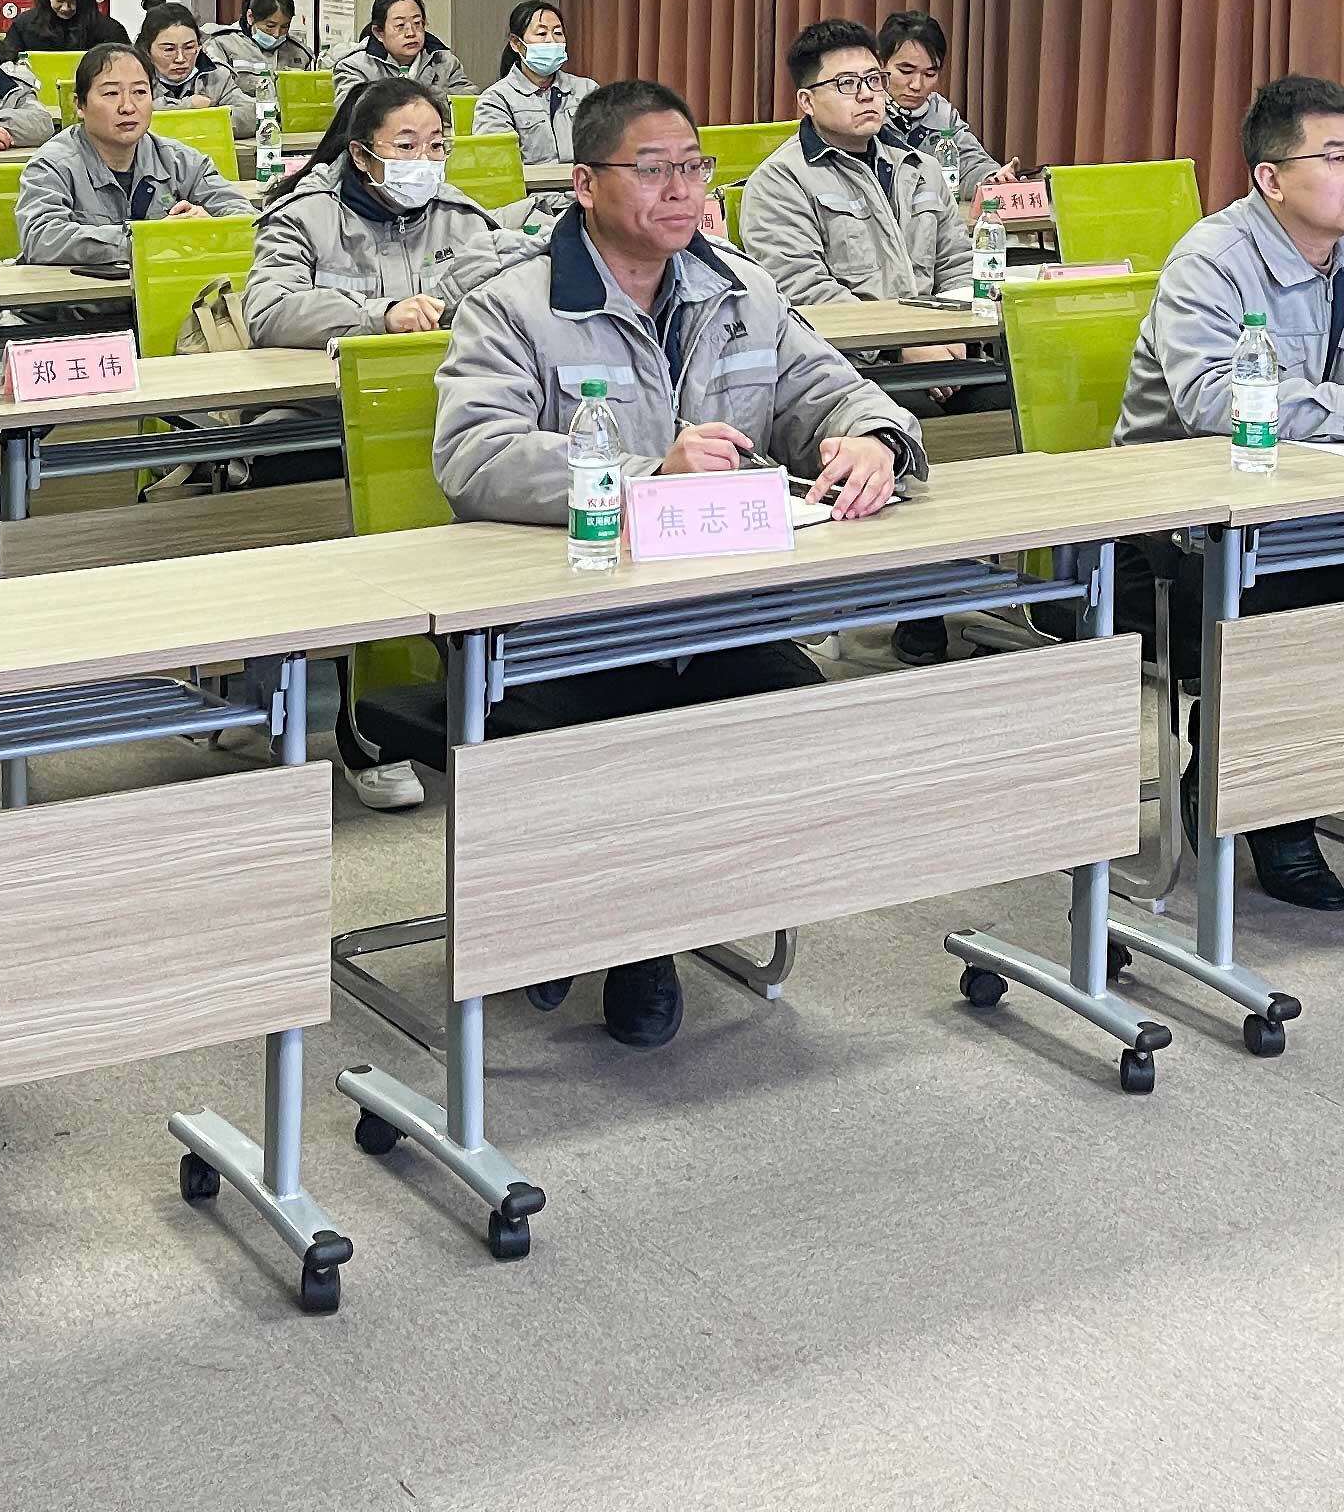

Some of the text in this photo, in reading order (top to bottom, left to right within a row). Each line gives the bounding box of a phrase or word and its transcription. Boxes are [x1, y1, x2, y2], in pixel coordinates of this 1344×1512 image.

[31, 353, 124, 386] 郑玉伟
[656, 499, 773, 538] 焦志强
